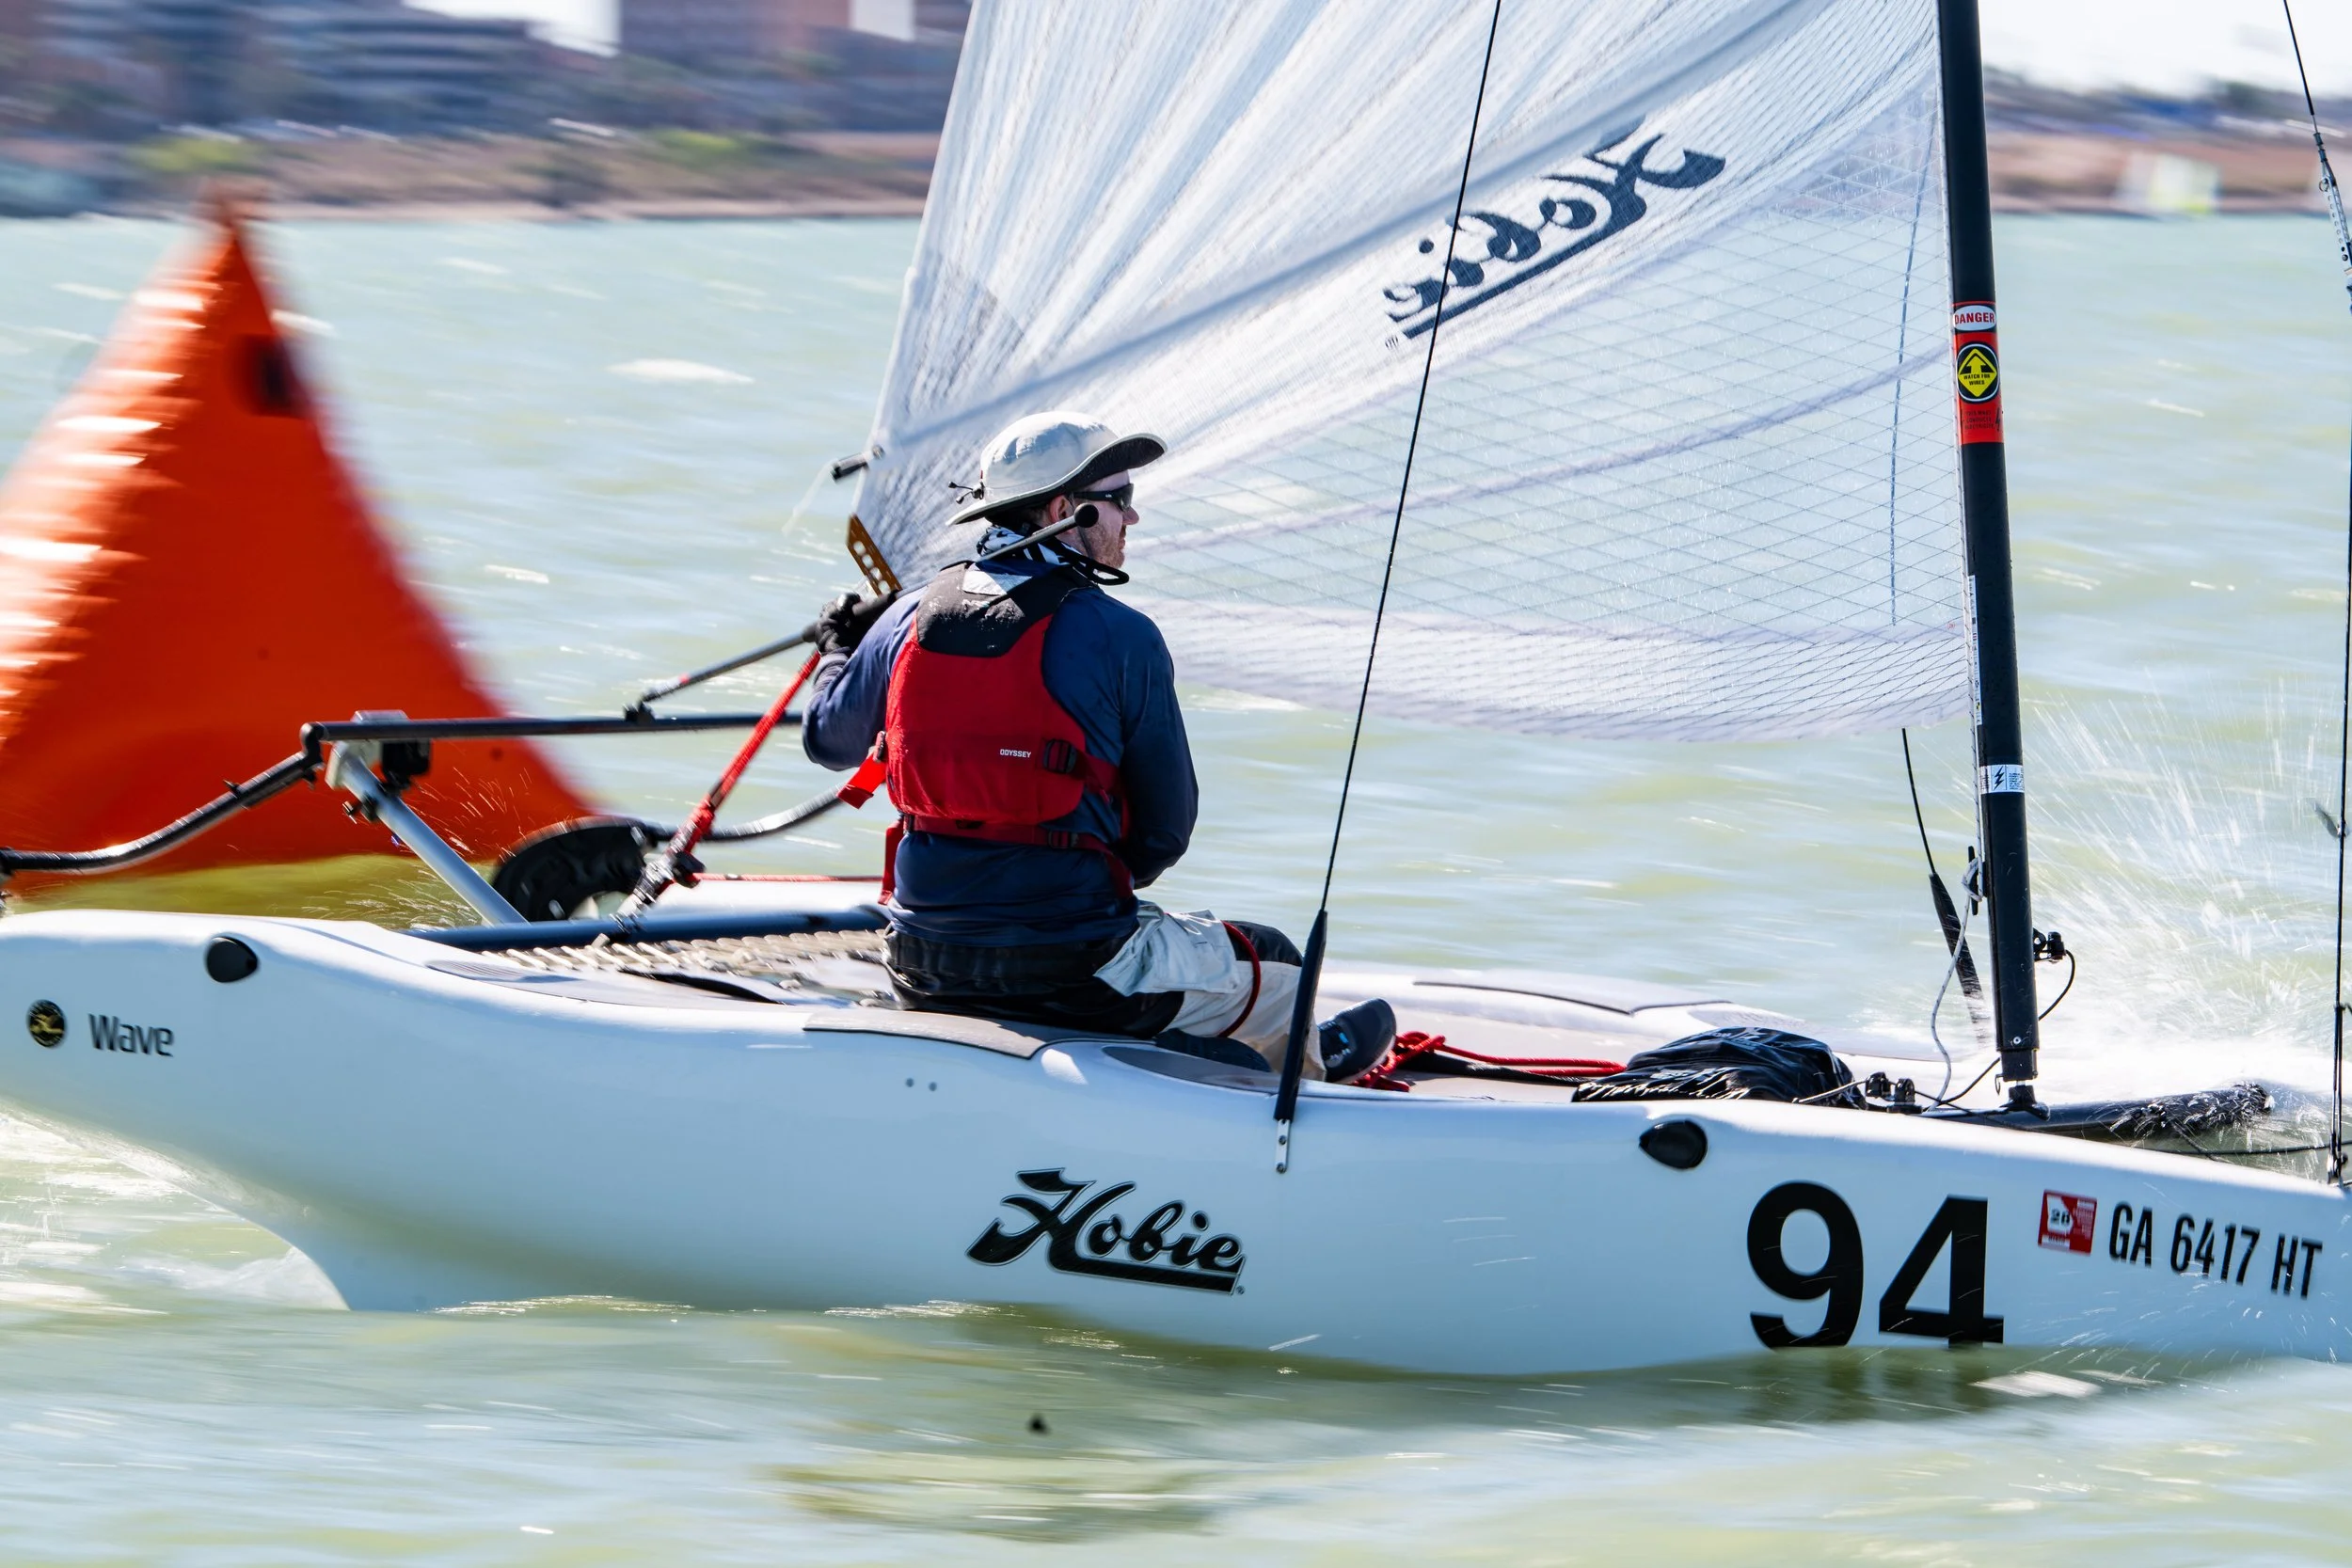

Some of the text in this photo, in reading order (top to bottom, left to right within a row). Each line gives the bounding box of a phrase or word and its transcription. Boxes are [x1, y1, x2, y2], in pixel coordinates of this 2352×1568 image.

[1954, 312, 1995, 325] DANGER
[1000, 749, 1032, 758] ODYSSEY
[88, 1013, 174, 1056] Wave
[964, 1166, 1247, 1296] Hobie
[1747, 1180, 2004, 1349] 94
[2109, 1200, 2153, 1267] GA
[2170, 1212, 2260, 1286] 6417
[2271, 1232, 2323, 1300] HT
